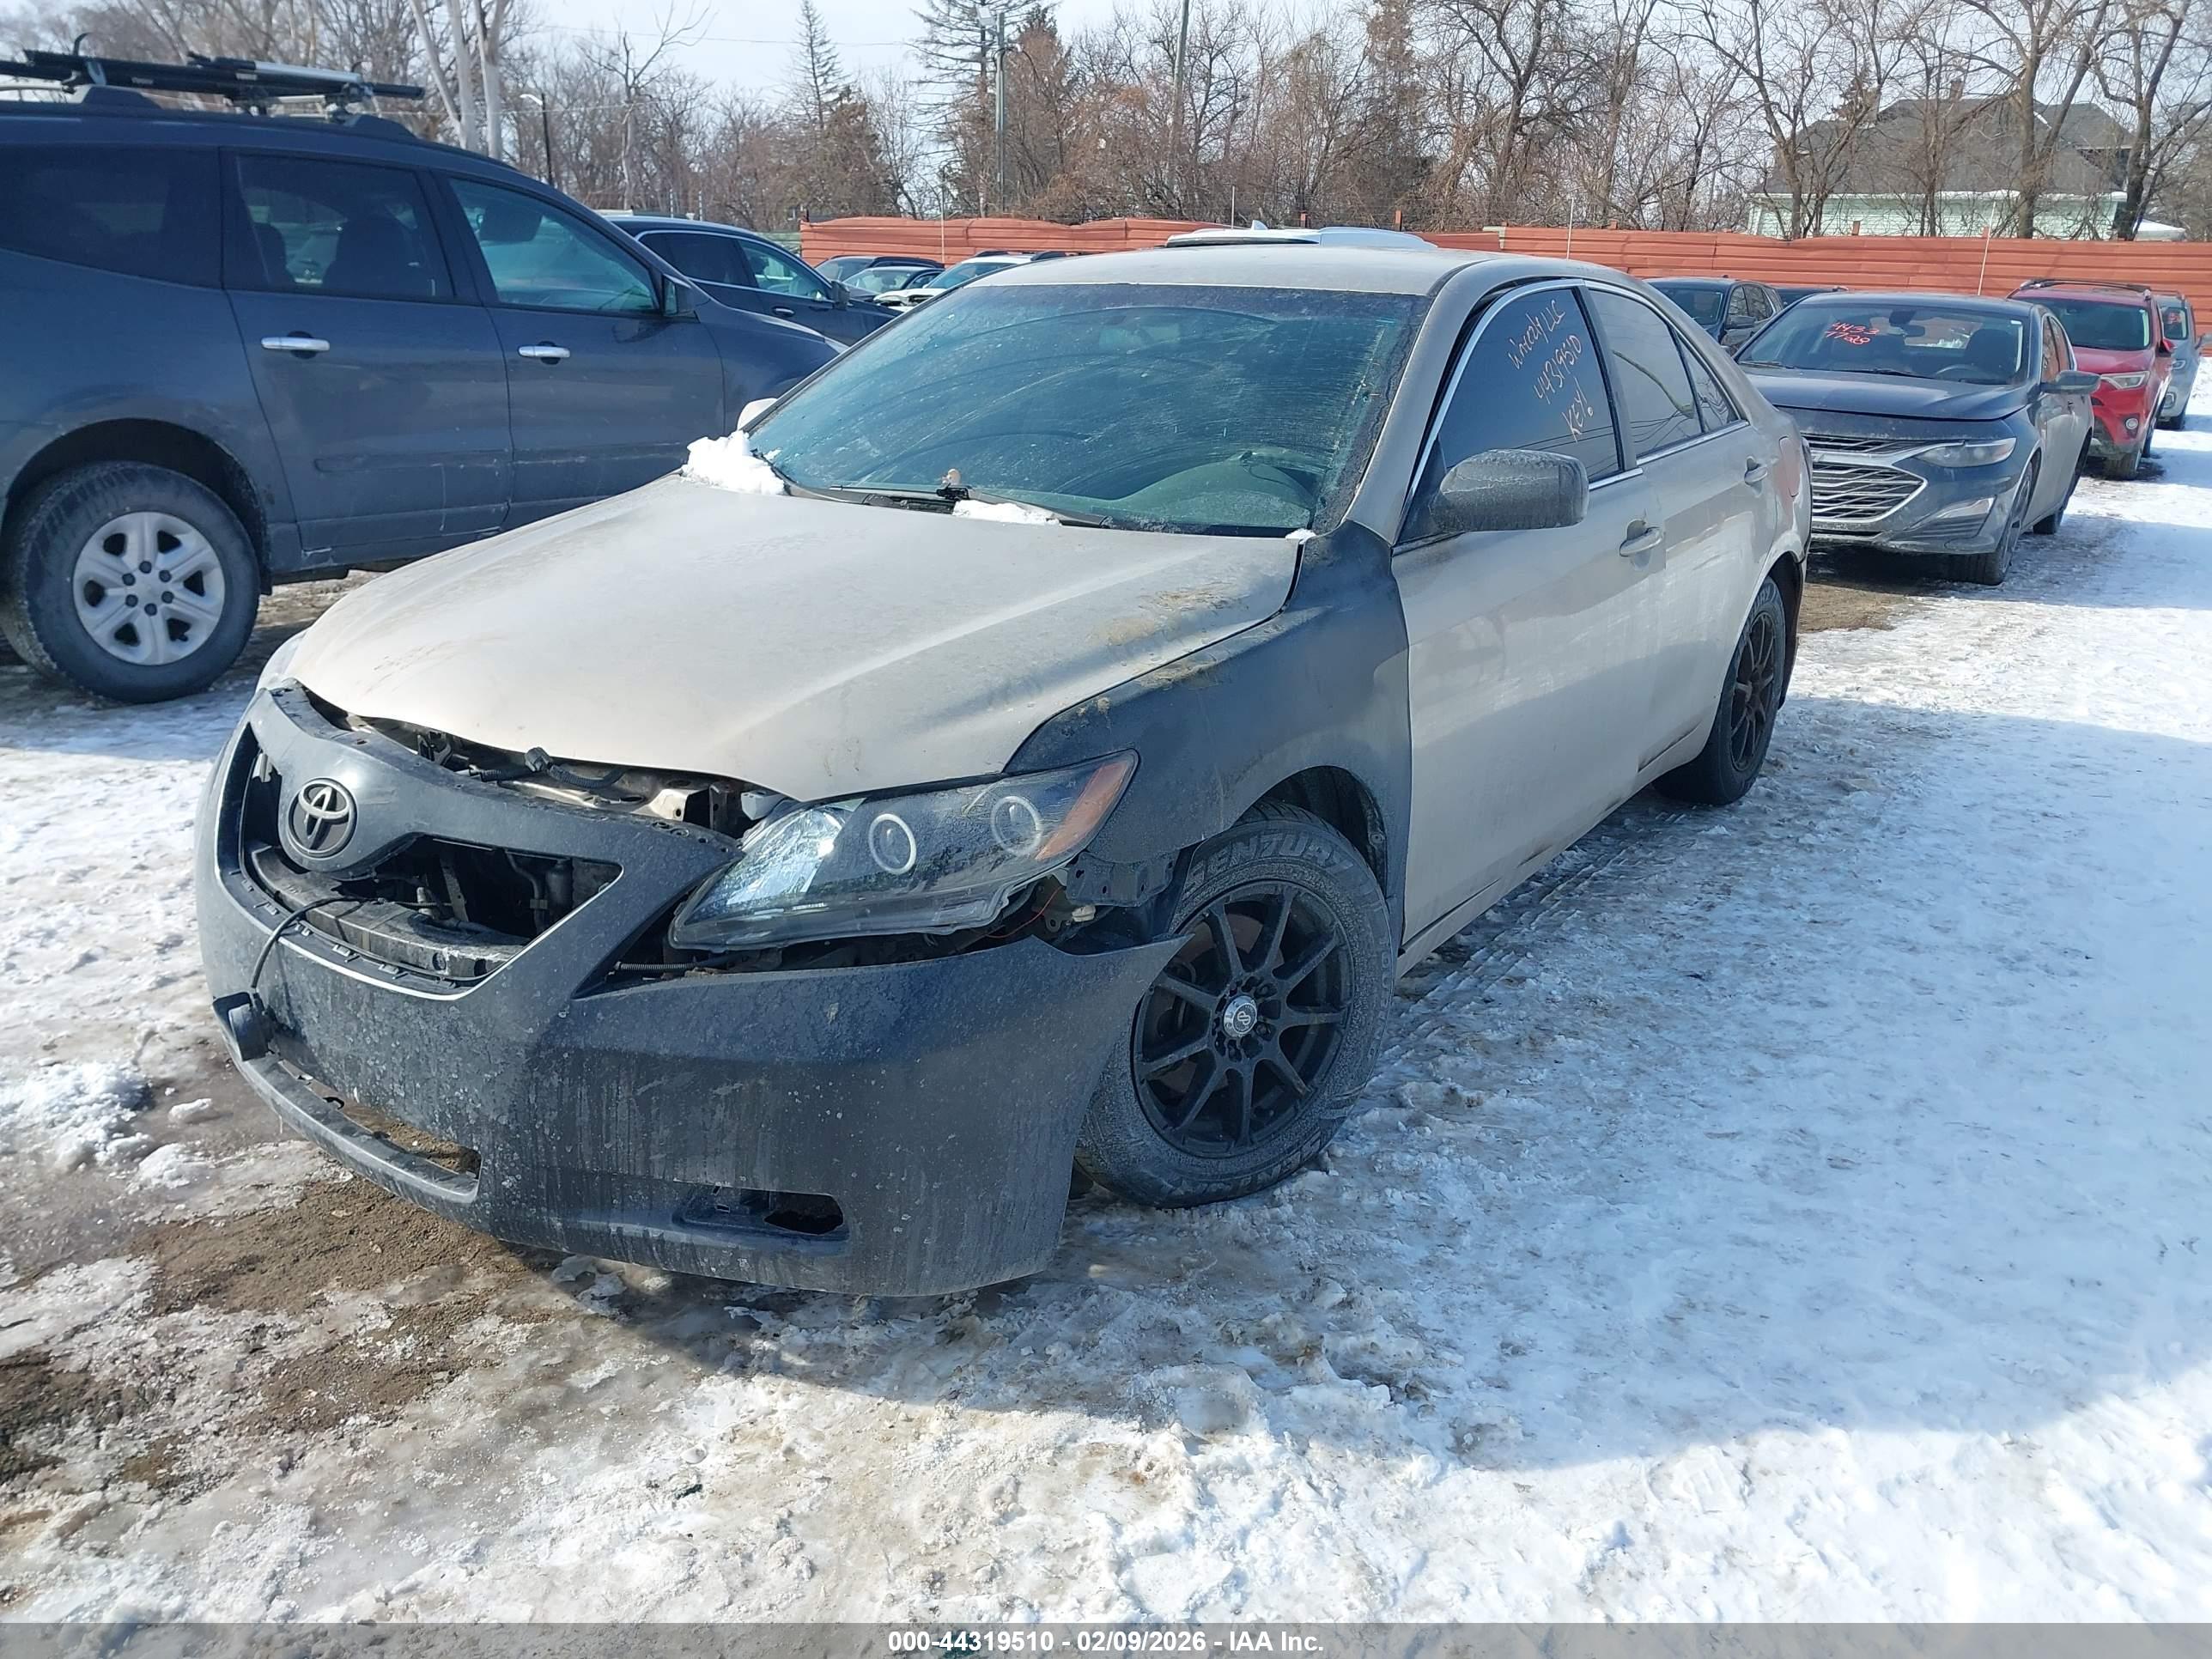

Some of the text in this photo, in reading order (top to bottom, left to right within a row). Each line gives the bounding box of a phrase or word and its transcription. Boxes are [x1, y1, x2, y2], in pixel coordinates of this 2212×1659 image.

[1540, 300, 1566, 331] LLC
[1832, 321, 1880, 336] 4433
[1534, 335, 1582, 404] 44319510
